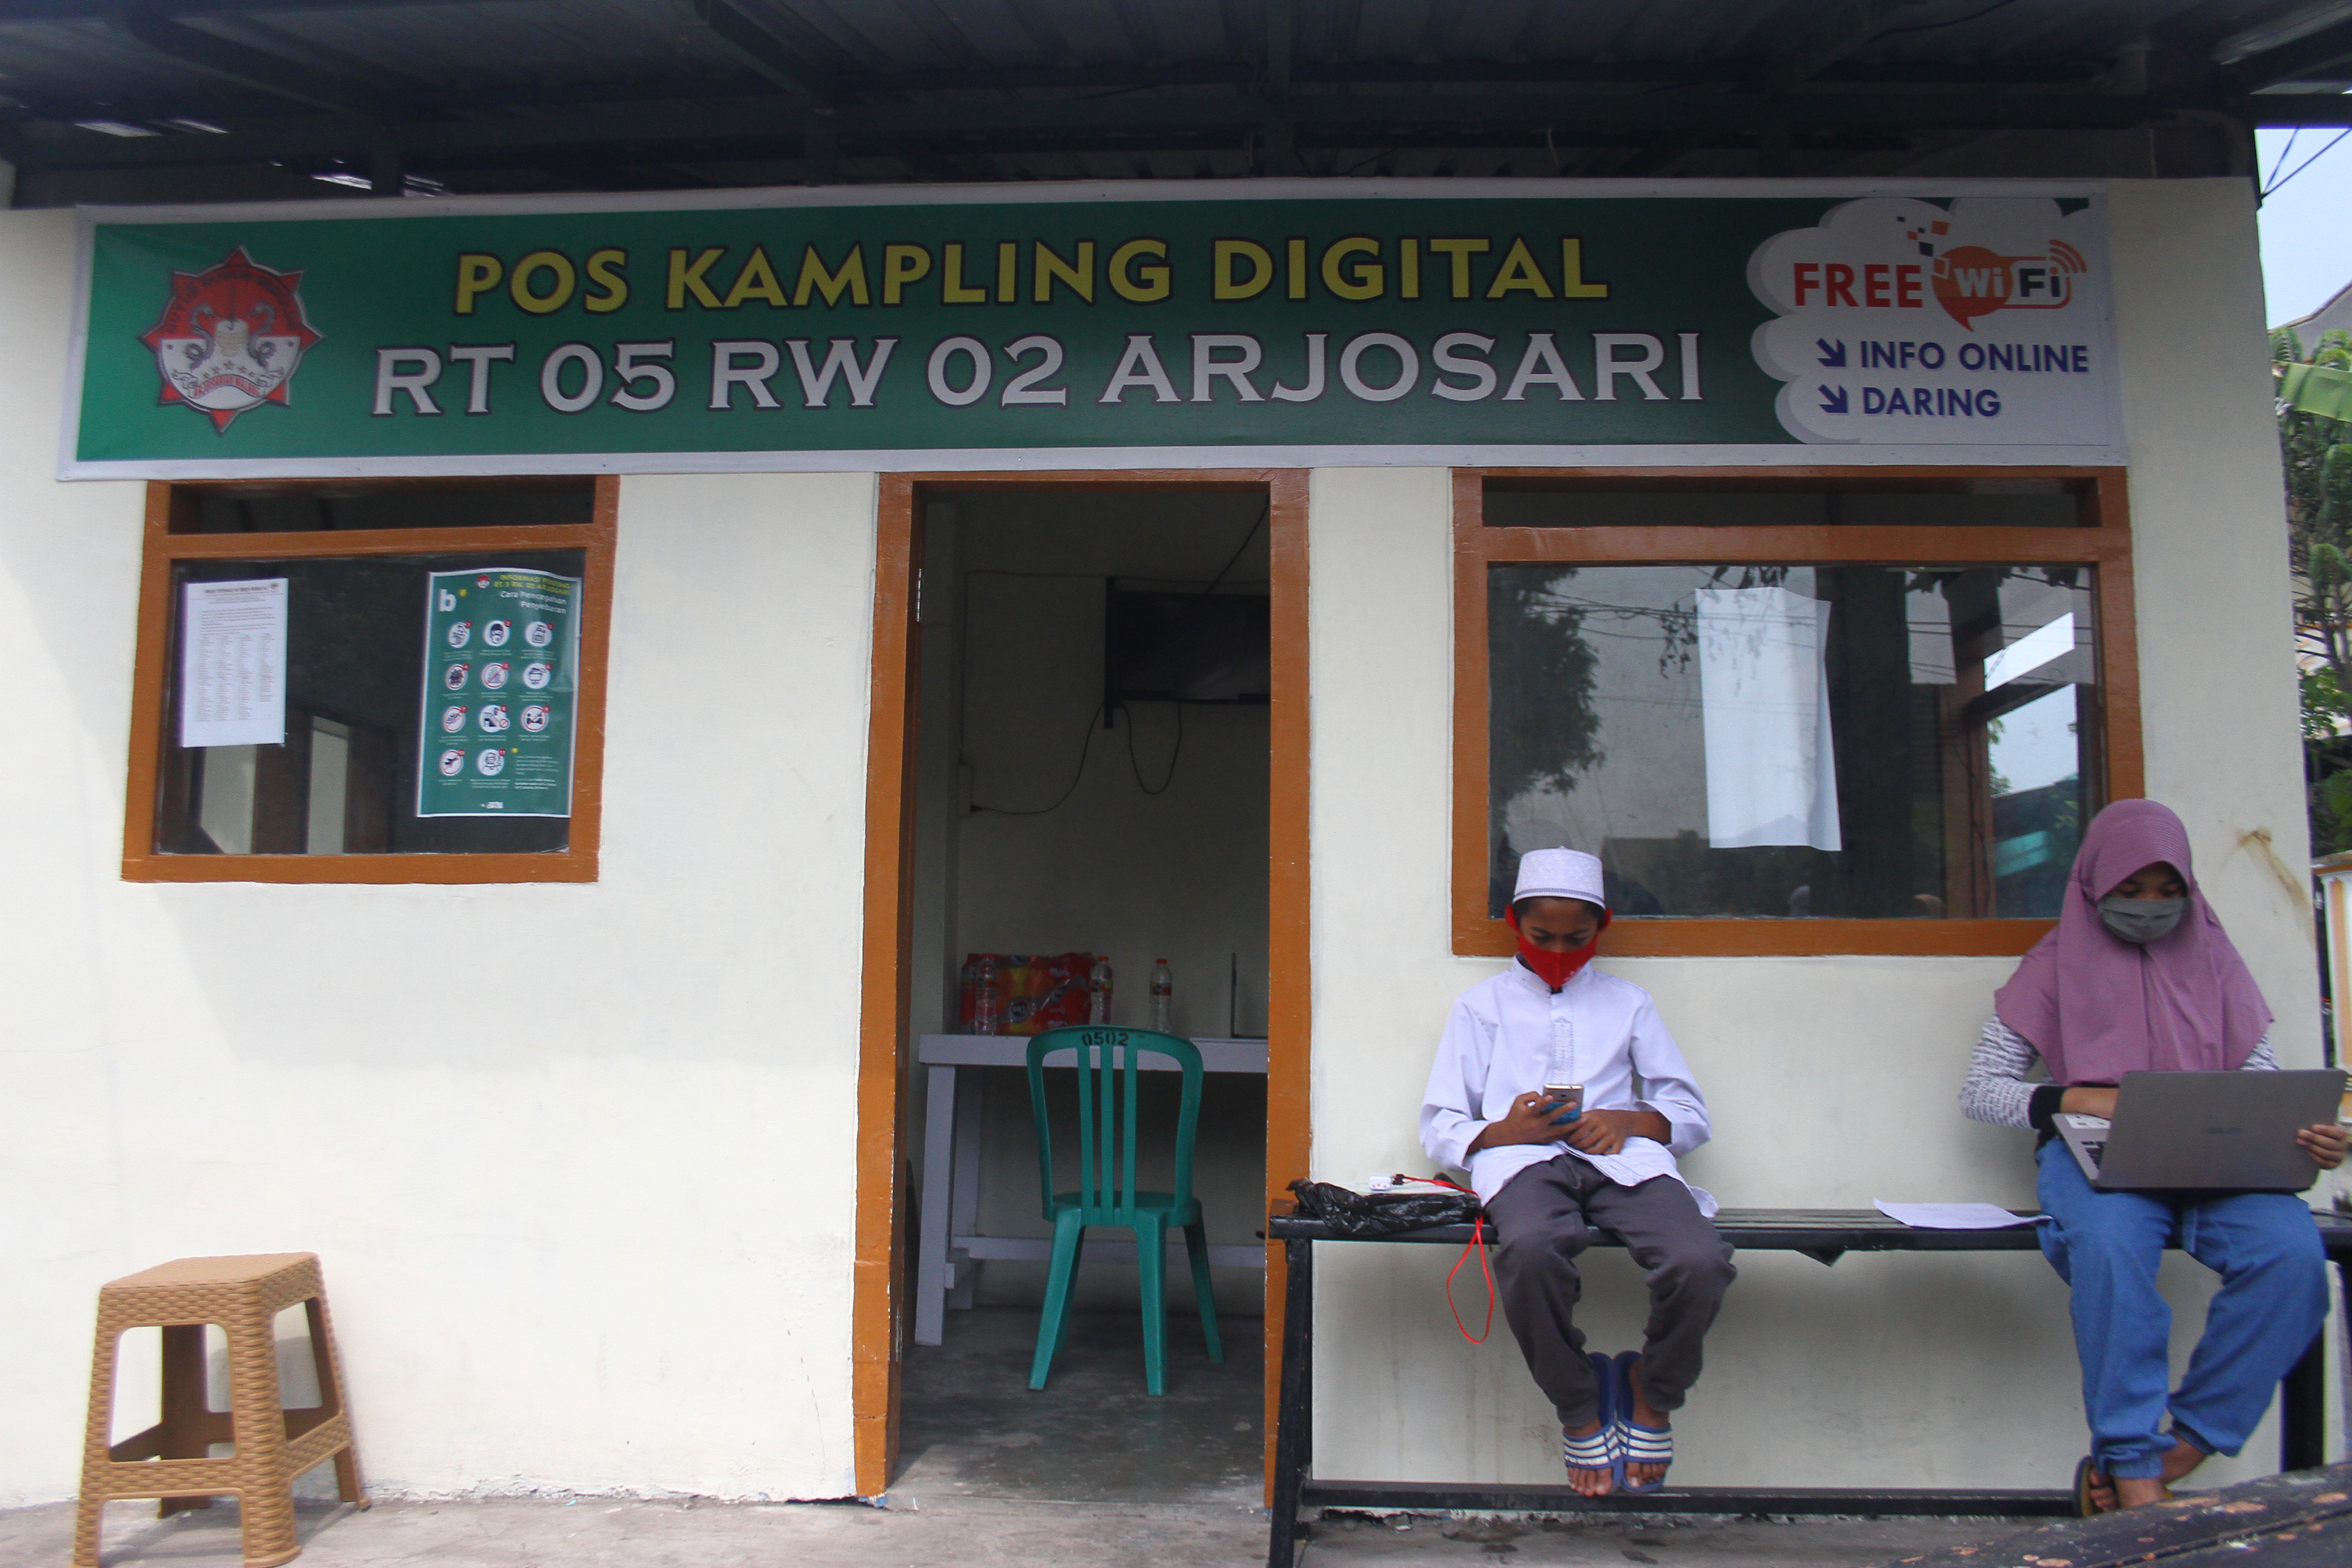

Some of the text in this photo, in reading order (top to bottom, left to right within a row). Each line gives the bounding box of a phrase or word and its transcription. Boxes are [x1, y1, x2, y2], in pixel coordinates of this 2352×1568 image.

[456, 237, 1608, 315] POS KAMPLING DIGITAL
[1793, 263, 1923, 308] FREE
[372, 331, 1703, 415] RT 05 RW 02 ARJOSARI
[1860, 340, 2089, 373] INFO ONLINE
[1862, 386, 2000, 417] DARING
[1081, 1030, 1130, 1047] 0502
